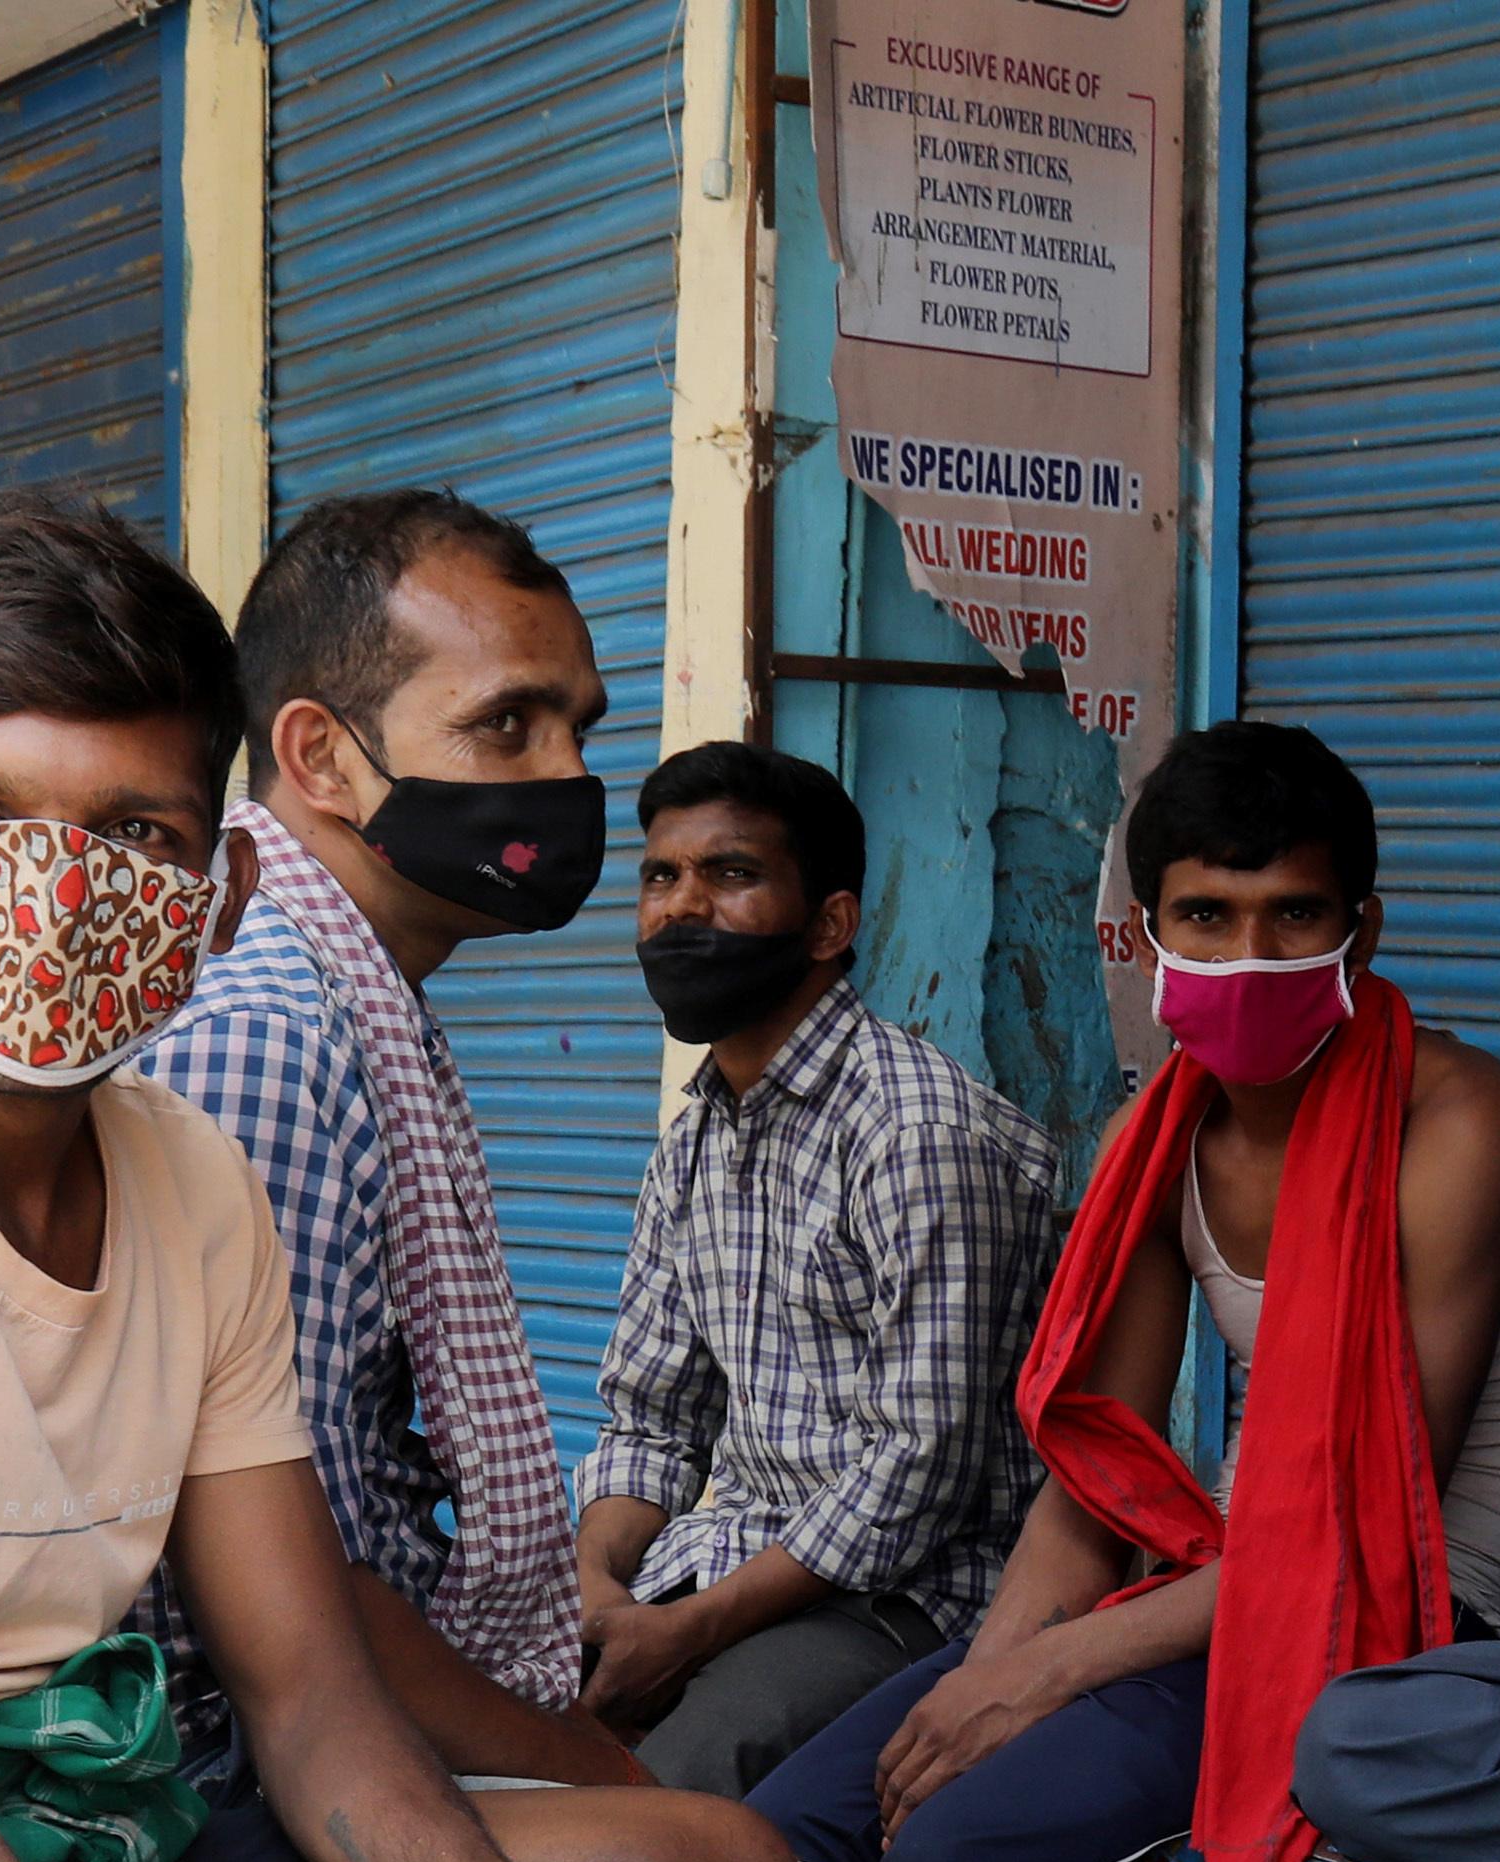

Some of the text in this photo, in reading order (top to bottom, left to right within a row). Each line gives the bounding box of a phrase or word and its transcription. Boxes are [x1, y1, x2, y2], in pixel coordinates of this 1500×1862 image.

[887, 37, 1100, 99] EXCLUSIVE RANGE OF
[848, 81, 1137, 156] ARTIFICIAL FLOWER BUNCHES,
[919, 135, 1072, 185] FLOWER STICKS,
[919, 177, 1072, 223] PLANTS FLOWER
[872, 211, 1116, 273] ARRANGEMENT MATERIAL,
[929, 261, 1062, 301] FLOWER POTS,
[921, 301, 1071, 344] FLOWER PETALS
[852, 435, 890, 484] WE
[900, 442, 1083, 503] SPECIALISED
[1093, 464, 1120, 506] IN
[958, 528, 1087, 581] WEDDING
[1099, 694, 1136, 737] OF
